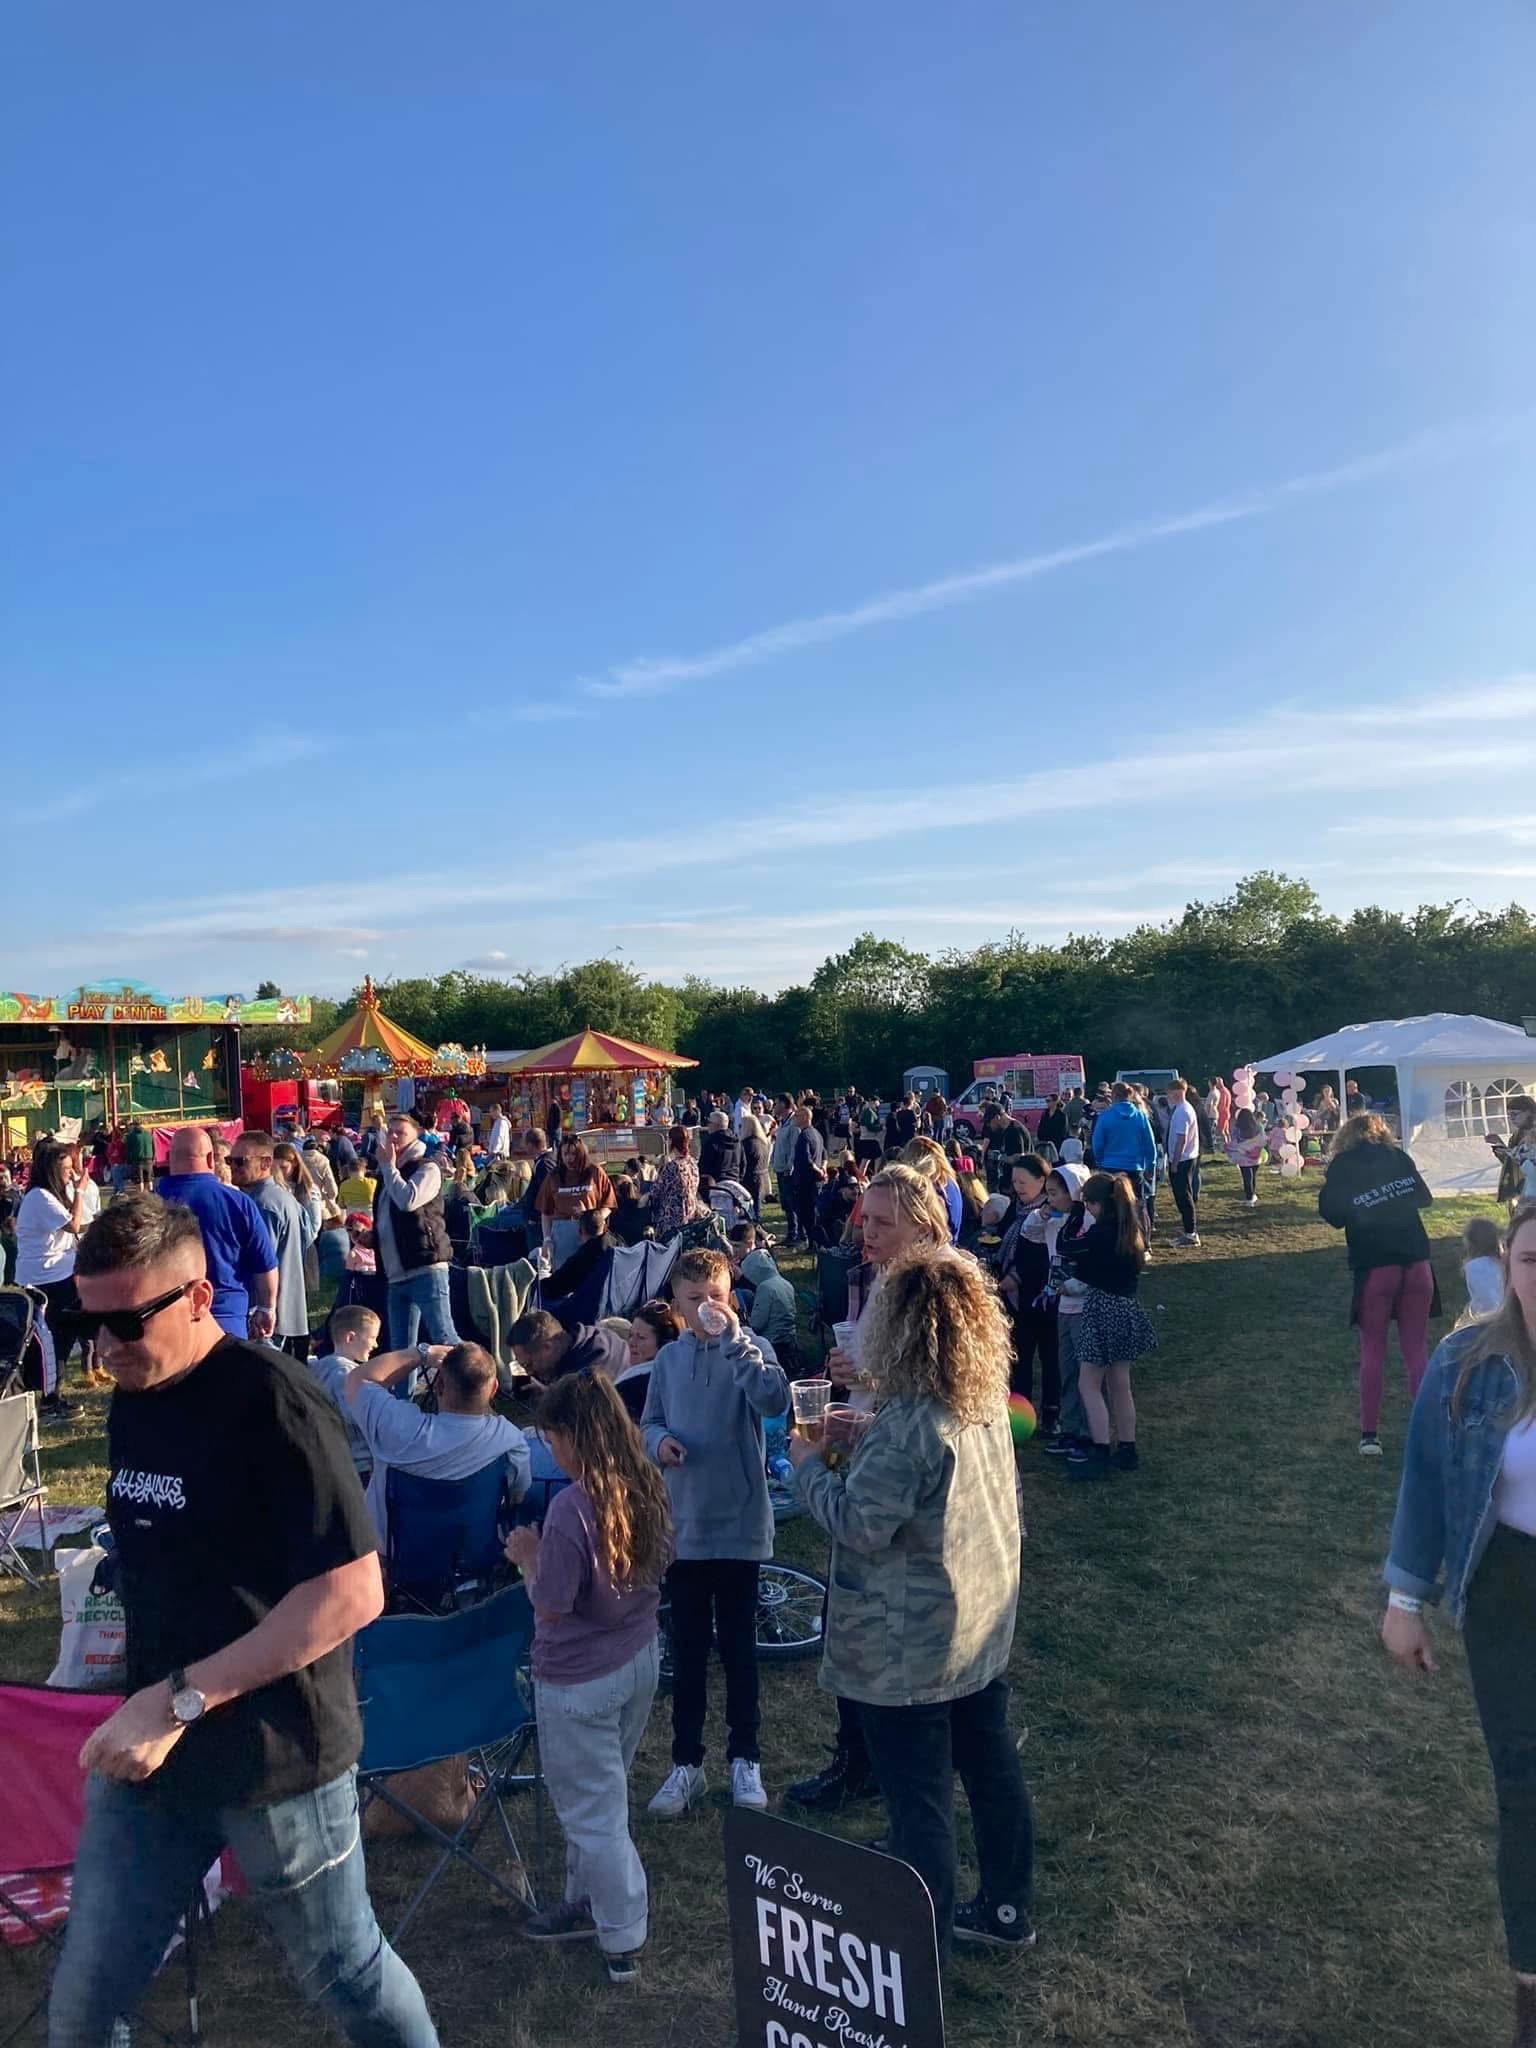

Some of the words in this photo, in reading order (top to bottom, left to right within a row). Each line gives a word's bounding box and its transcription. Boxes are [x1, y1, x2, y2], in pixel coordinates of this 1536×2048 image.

[68, 1004, 105, 1019] PLAY
[112, 1004, 167, 1020] CENTRE
[1381, 1176, 1416, 1193] KITCHEN
[113, 1468, 183, 1497] ALLSAINTS
[75, 1610, 125, 1623] RECYCL
[744, 1854, 789, 1889] We
[783, 1873, 843, 1916] Serve
[756, 1896, 906, 2027] FRESH
[763, 1976, 820, 2022] Hand
